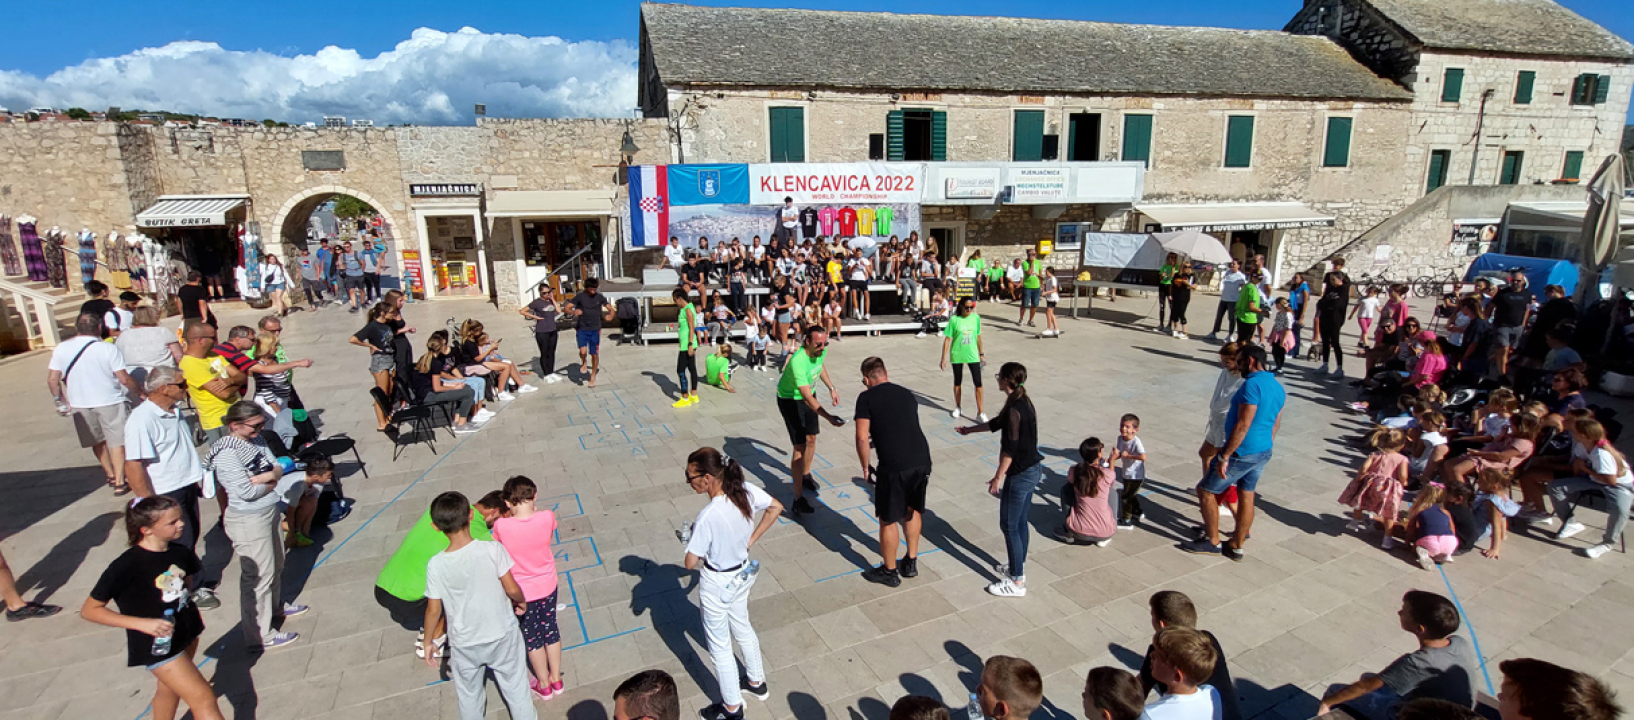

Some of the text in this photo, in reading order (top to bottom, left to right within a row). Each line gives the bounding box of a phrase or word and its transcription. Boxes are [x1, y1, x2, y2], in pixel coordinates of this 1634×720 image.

[760, 175, 915, 192] KLENCAVICA 2022
[554, 548, 569, 562] 4
